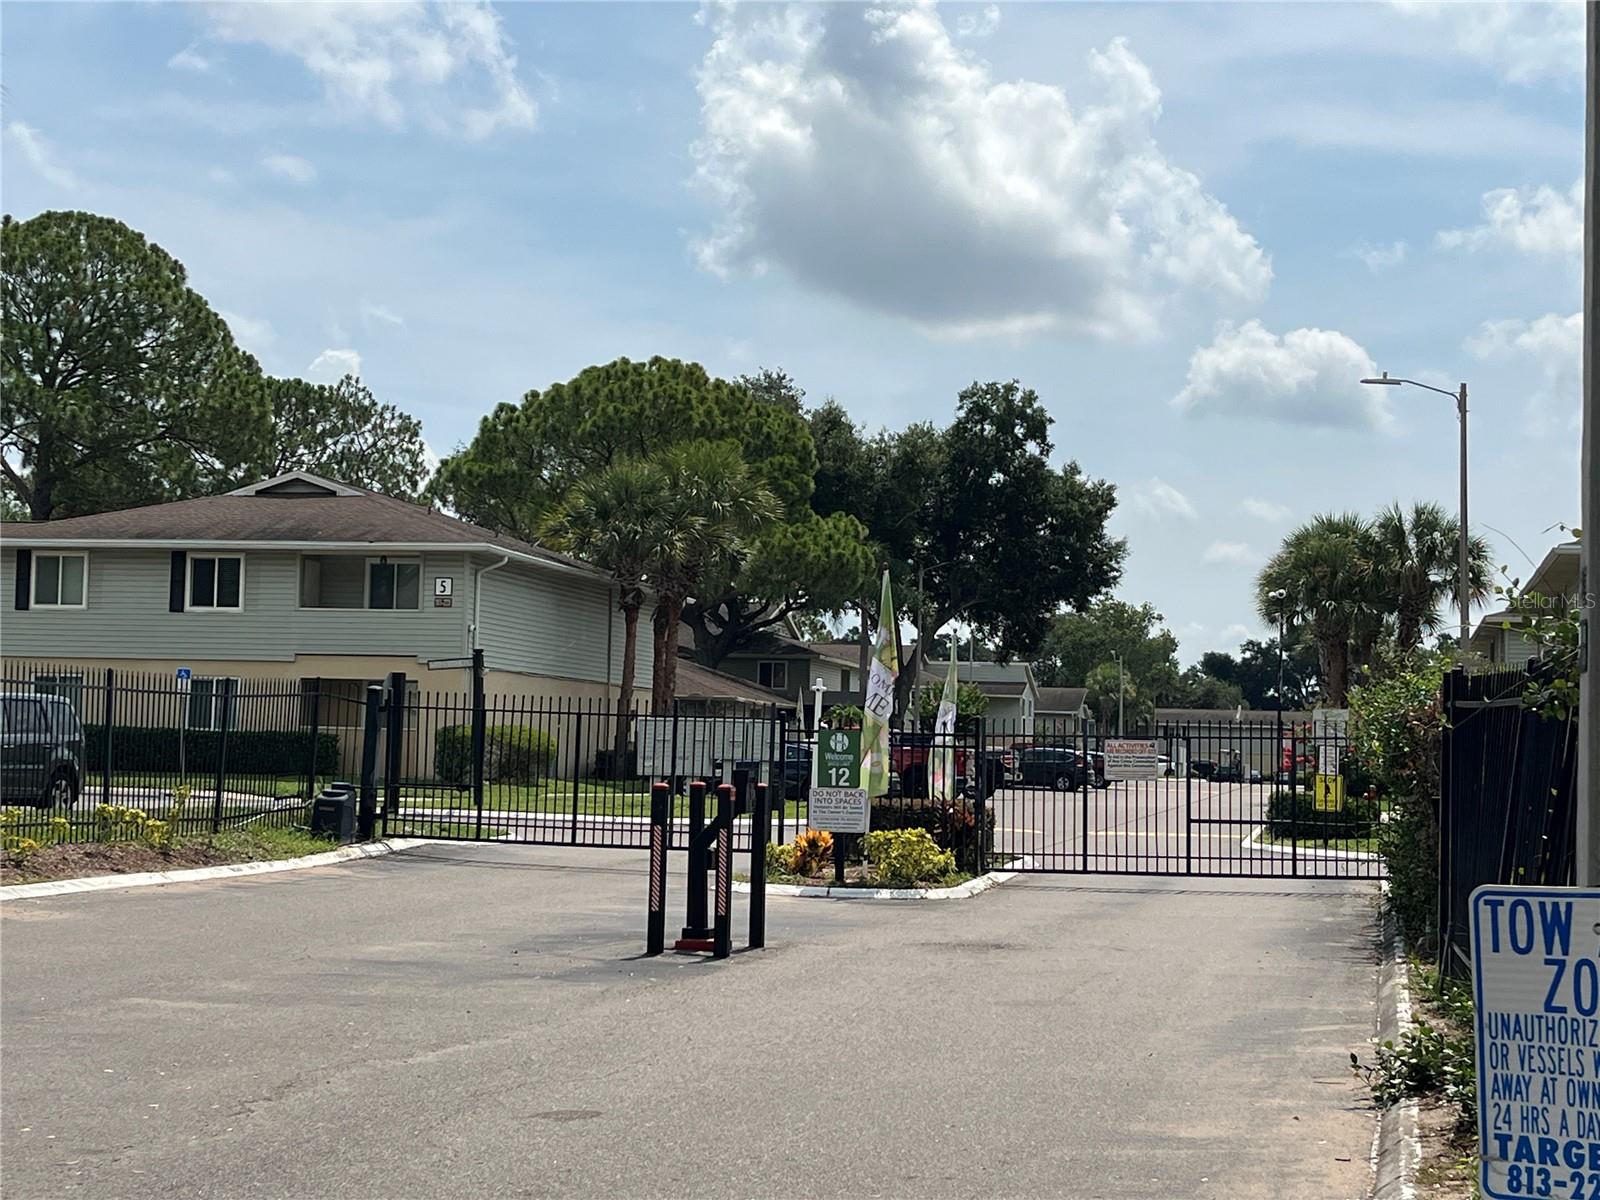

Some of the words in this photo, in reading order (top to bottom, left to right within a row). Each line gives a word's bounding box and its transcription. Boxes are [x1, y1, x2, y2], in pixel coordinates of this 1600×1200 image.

[439, 580, 446, 593] 5
[824, 752, 854, 761] Welcome
[813, 790, 824, 798] DO
[826, 790, 841, 798] NOT
[828, 767, 850, 786] 12
[814, 797, 833, 805] INTO
[1483, 898, 1573, 956] TOW
[1544, 958, 1599, 1018] ZO
[1488, 1012, 1599, 1048] UNAUTHORIZ
[1489, 1041, 1509, 1070] OR
[1518, 1044, 1584, 1078] VESSELS
[1491, 1072, 1532, 1103] AWAY
[1540, 1076, 1558, 1105] AT
[1566, 1078, 1600, 1110] OWN
[1492, 1102, 1512, 1131] 24
[1520, 1104, 1550, 1135] HRS
[1559, 1108, 1570, 1137] A
[1493, 1132, 1600, 1171] TARGE
[1507, 1163, 1600, 1200] 813-22
